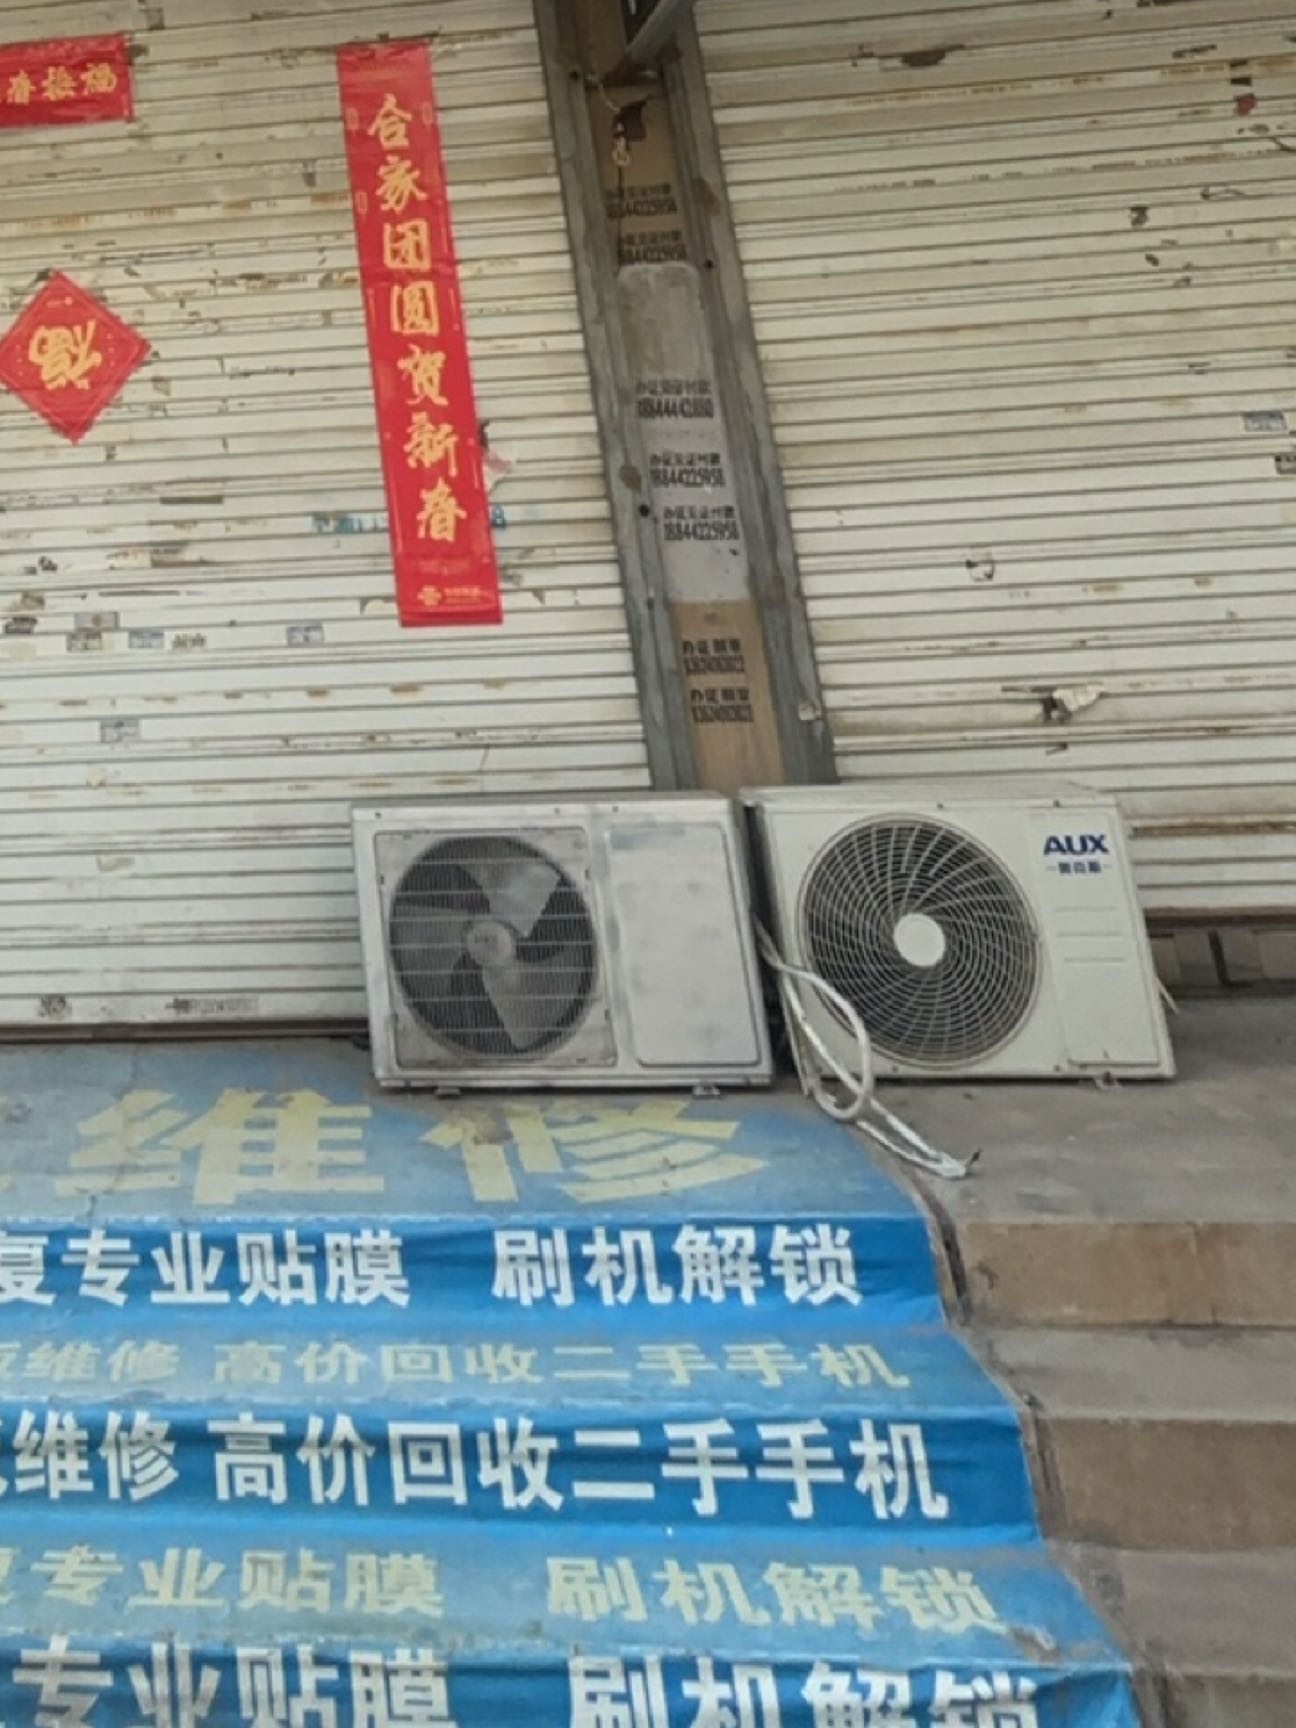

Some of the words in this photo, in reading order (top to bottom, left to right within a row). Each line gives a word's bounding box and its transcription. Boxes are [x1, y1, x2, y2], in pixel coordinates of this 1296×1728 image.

[27, 317, 103, 391] 福
[1043, 833, 1109, 856] AUX
[492, 1223, 861, 1307] 刷机解锁
[213, 1341, 910, 1390] 高价回收二手手机
[206, 1412, 949, 1520] 高价回收二手手机
[545, 1554, 1009, 1633] 刷机解锁
[567, 1648, 1044, 1728] 刷机解锁
